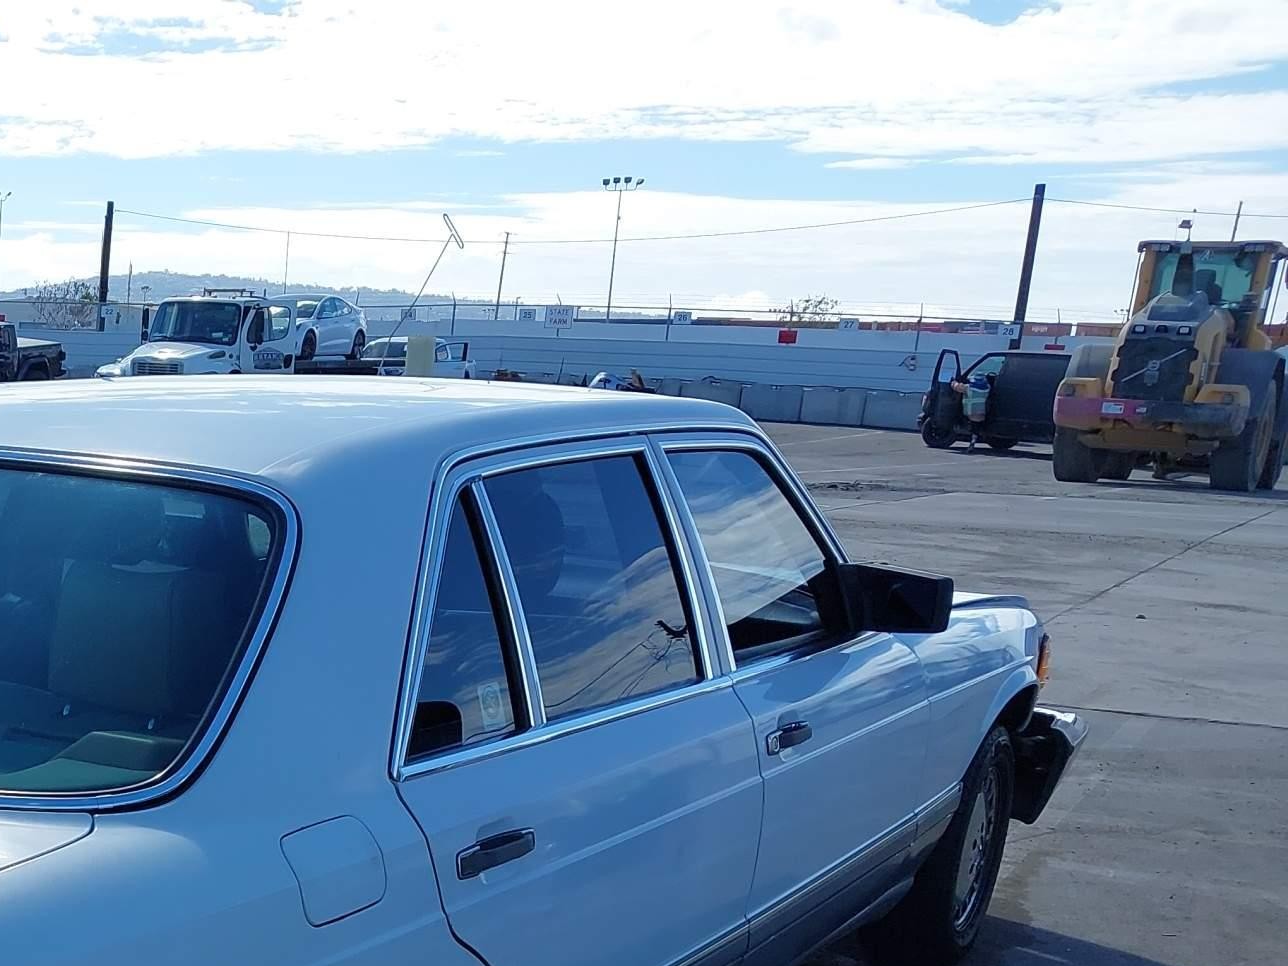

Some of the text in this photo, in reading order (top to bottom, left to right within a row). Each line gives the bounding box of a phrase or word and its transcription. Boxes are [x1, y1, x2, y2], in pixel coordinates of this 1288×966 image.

[523, 311, 533, 319] 25
[677, 314, 688, 322] 26
[843, 320, 854, 329] 27
[1002, 327, 1014, 336] 28
